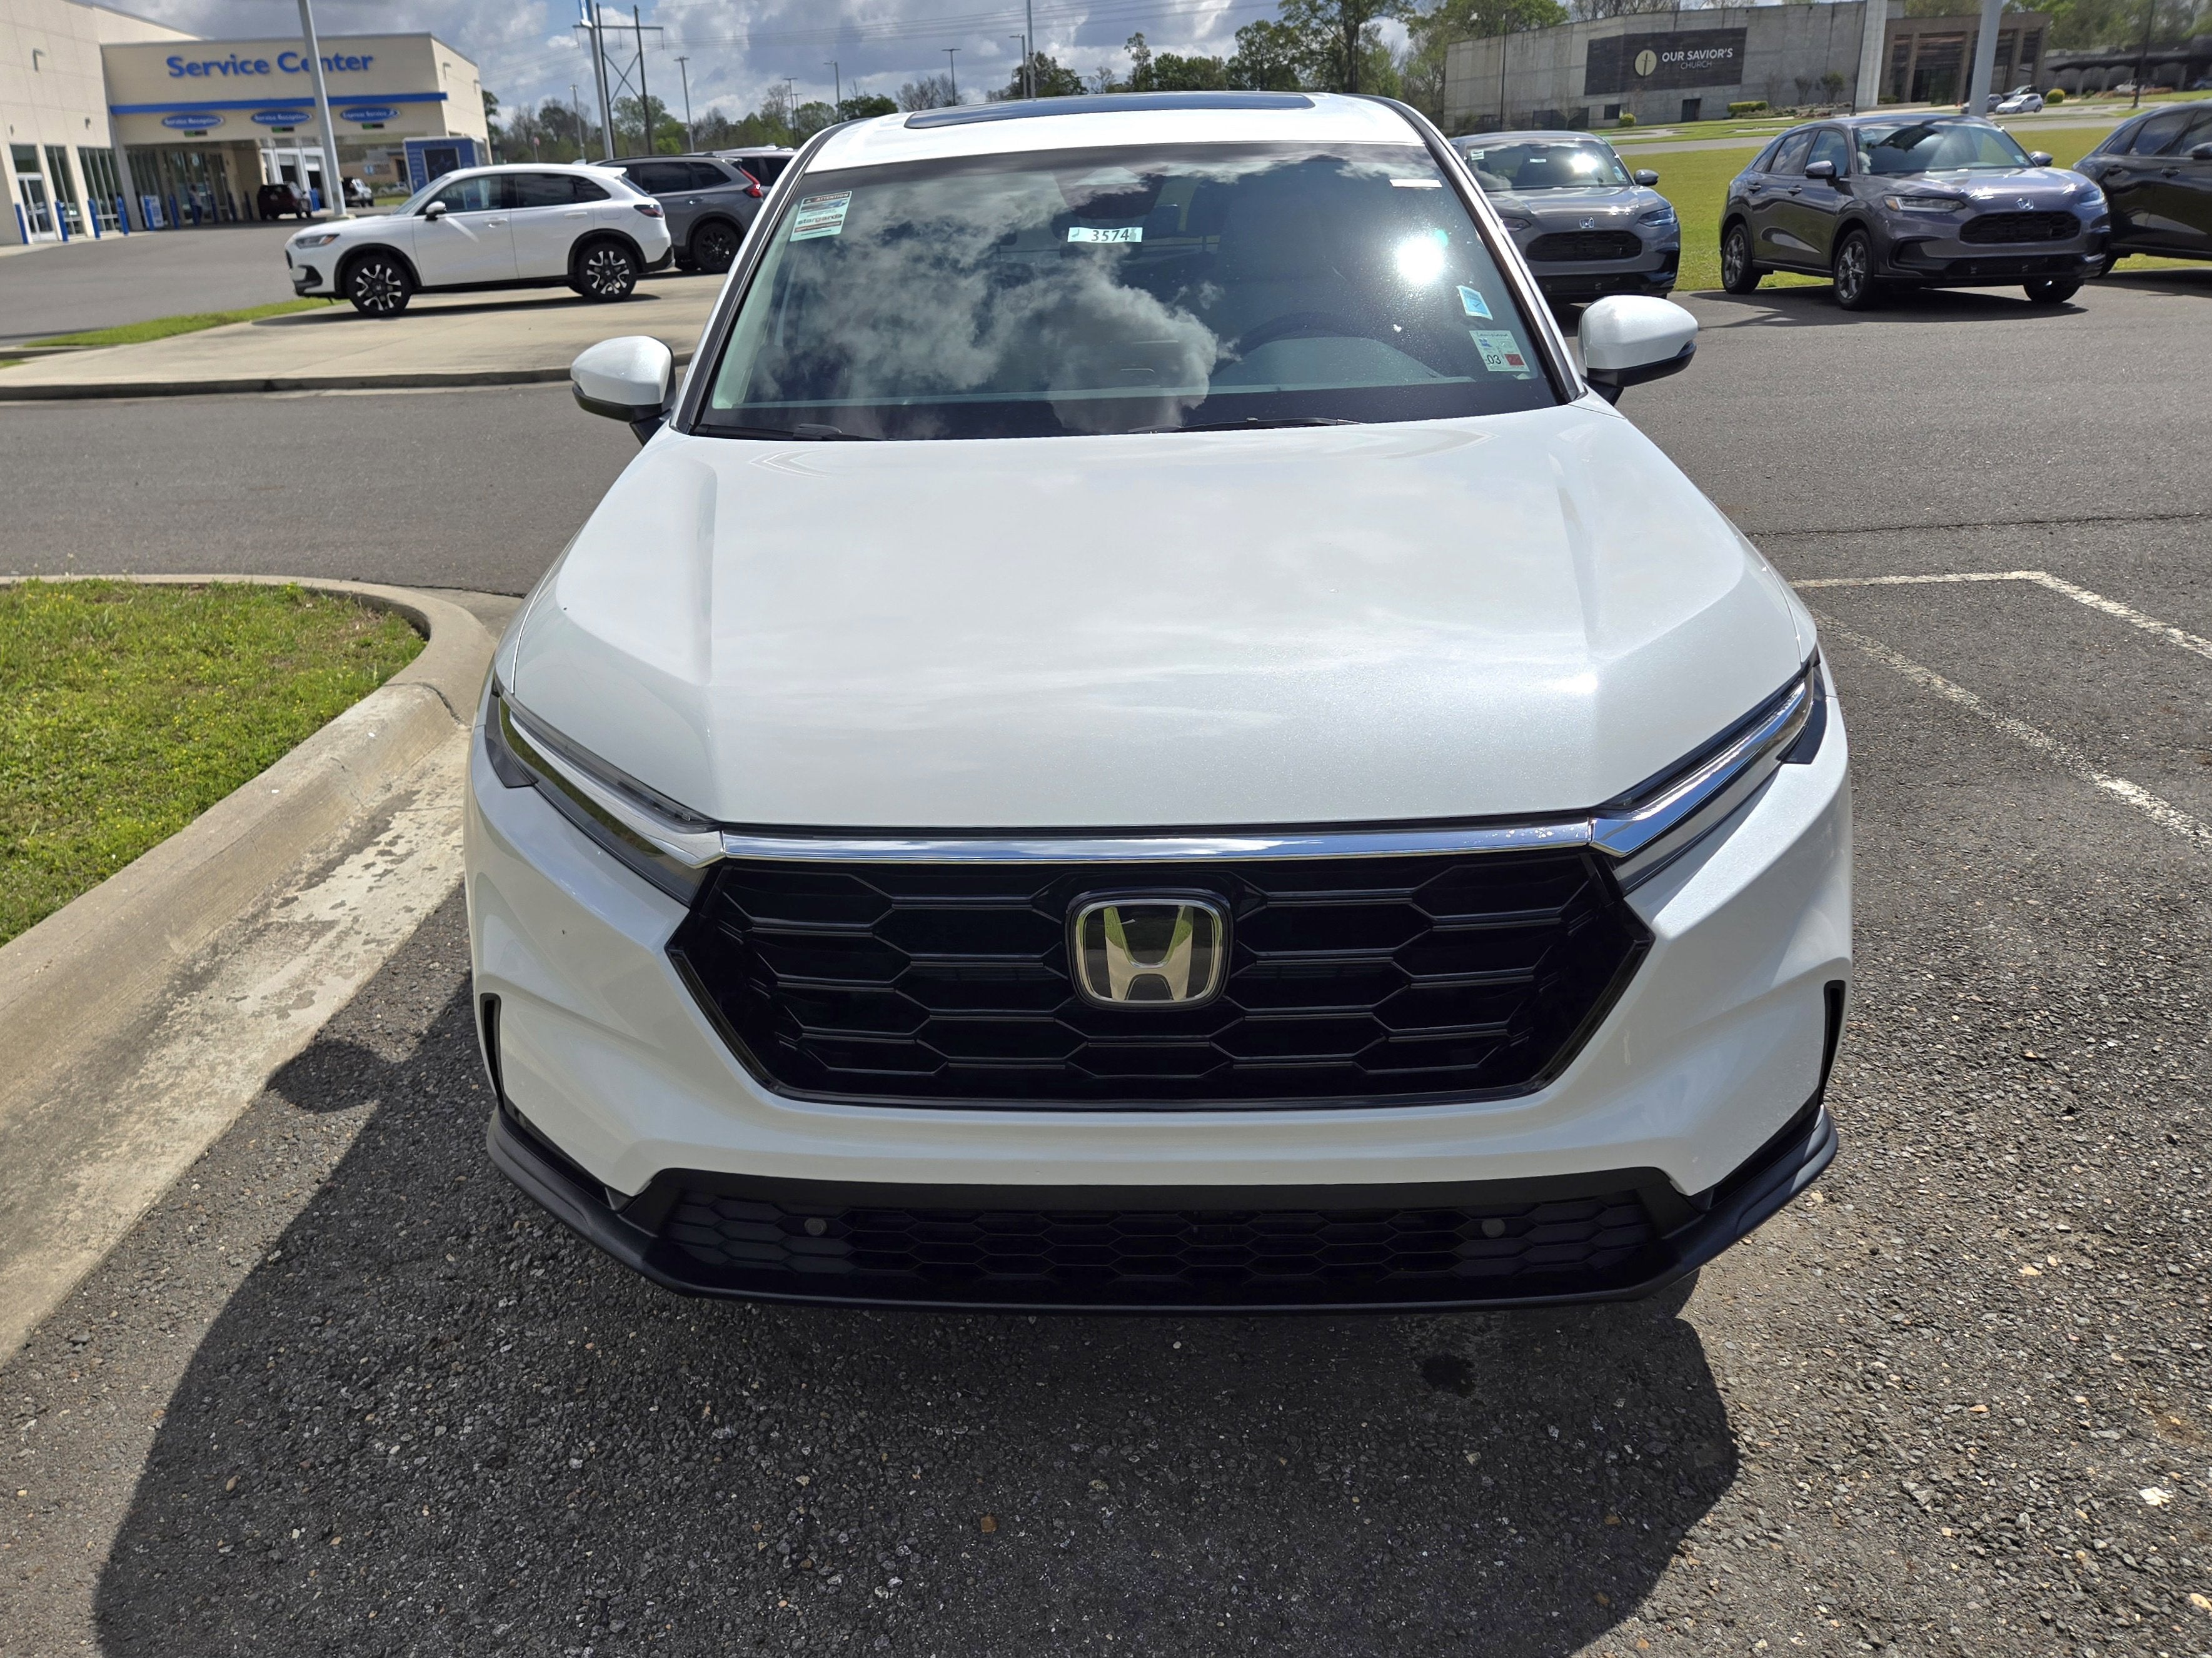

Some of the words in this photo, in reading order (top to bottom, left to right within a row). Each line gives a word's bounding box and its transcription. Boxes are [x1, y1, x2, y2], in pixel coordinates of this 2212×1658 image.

[1662, 51, 1684, 63] OUR
[1687, 48, 1734, 61] SAVIOR'S
[166, 54, 269, 78] Service
[1681, 61, 1712, 70] CHURCH
[816, 193, 848, 201] ATTENTION
[1091, 229, 1129, 241] 3574
[1487, 354, 1501, 364] 03
